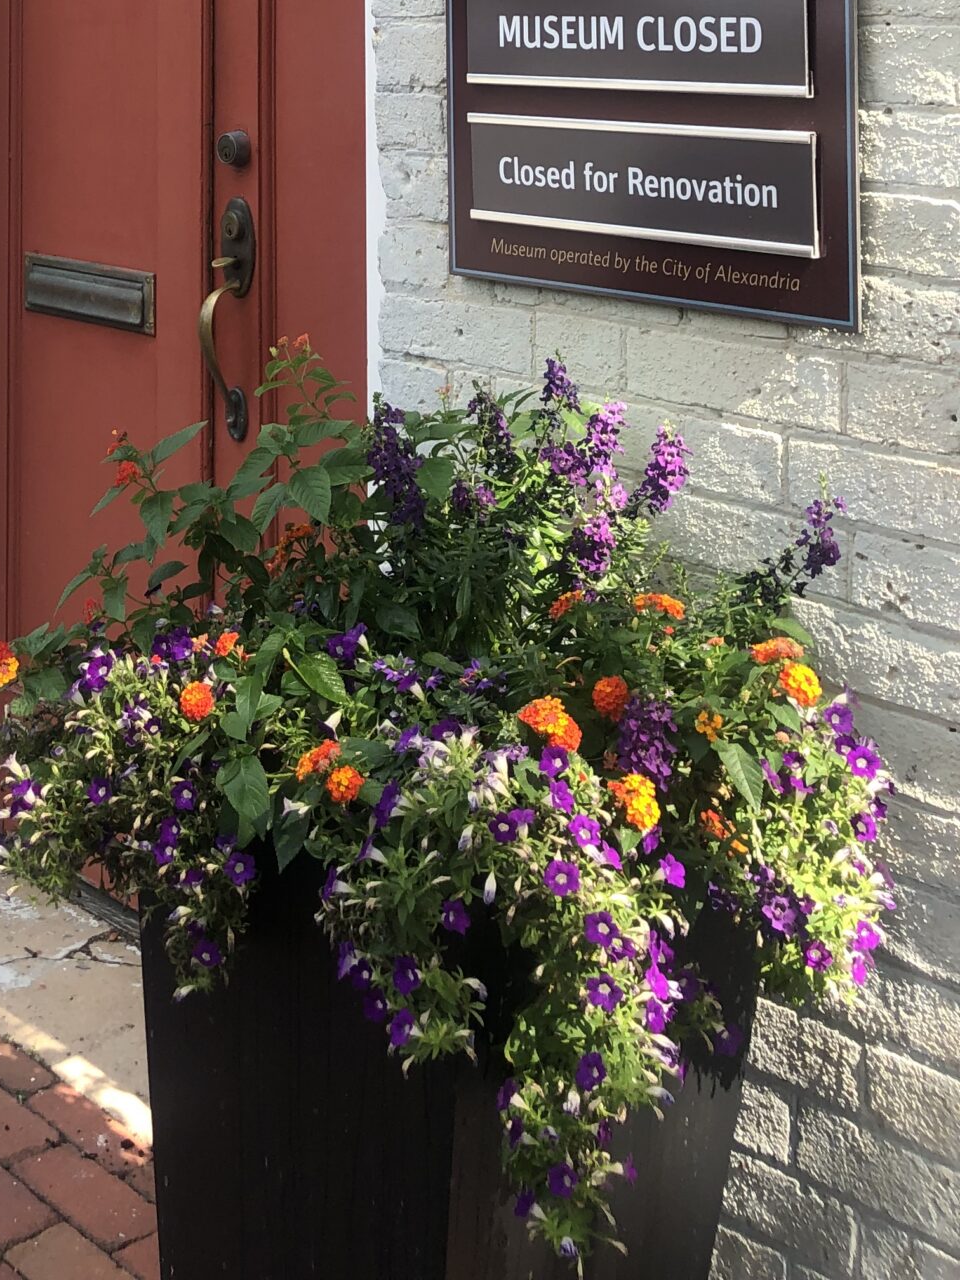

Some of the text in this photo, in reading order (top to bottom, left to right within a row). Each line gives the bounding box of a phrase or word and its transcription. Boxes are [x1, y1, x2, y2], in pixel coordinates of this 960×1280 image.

[498, 14, 763, 54] MUSEUM CLOSED
[498, 156, 779, 209] Closed for Renovation
[490, 237, 801, 293] Museum operated by the City of Alexandria
